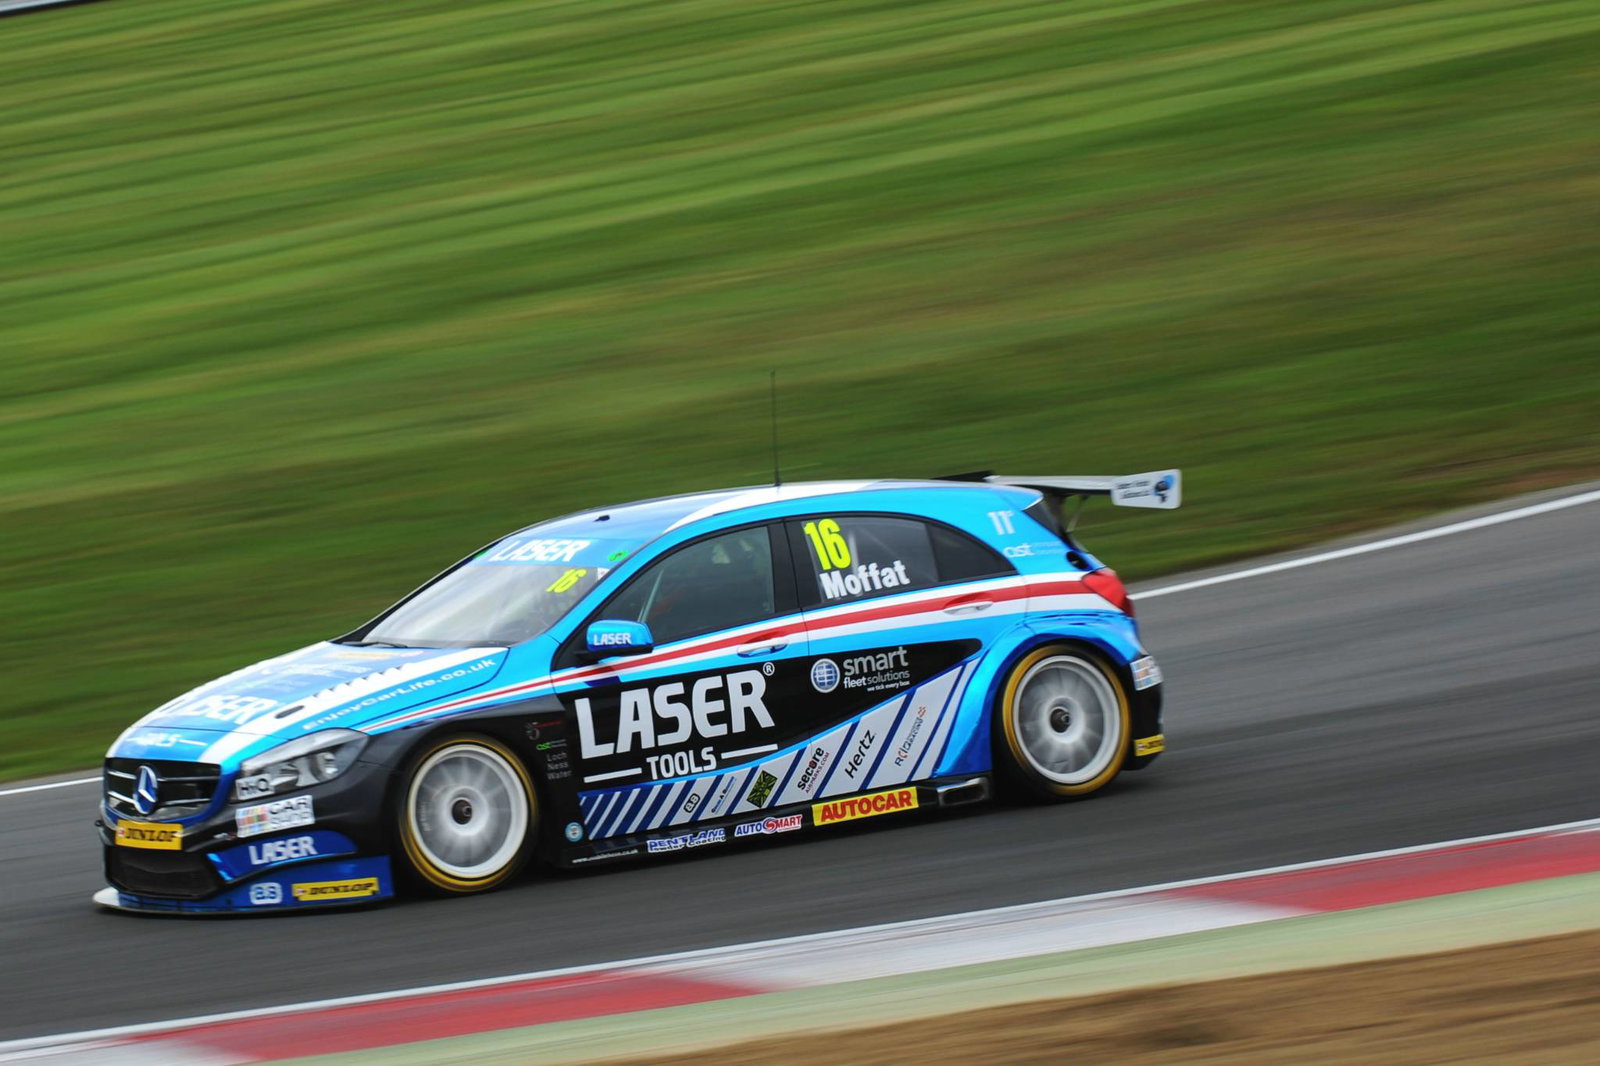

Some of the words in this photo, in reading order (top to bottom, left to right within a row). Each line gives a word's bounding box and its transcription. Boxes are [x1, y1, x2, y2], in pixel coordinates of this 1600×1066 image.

[488, 540, 591, 563] LASER
[804, 518, 851, 571] 16
[546, 568, 587, 593] 16
[819, 560, 911, 600] Moffat
[593, 632, 632, 646] LASER
[843, 646, 909, 676] smart
[843, 676, 867, 688] fleet
[867, 670, 910, 684] solutions
[646, 746, 717, 780] TOOLS
[797, 747, 825, 790] secure
[844, 729, 876, 780] Hertz
[820, 790, 912, 822] AUTOCAR
[649, 829, 725, 851] PENTLAND
[736, 815, 802, 836] AUTOSMART
[248, 836, 318, 865] LASER
